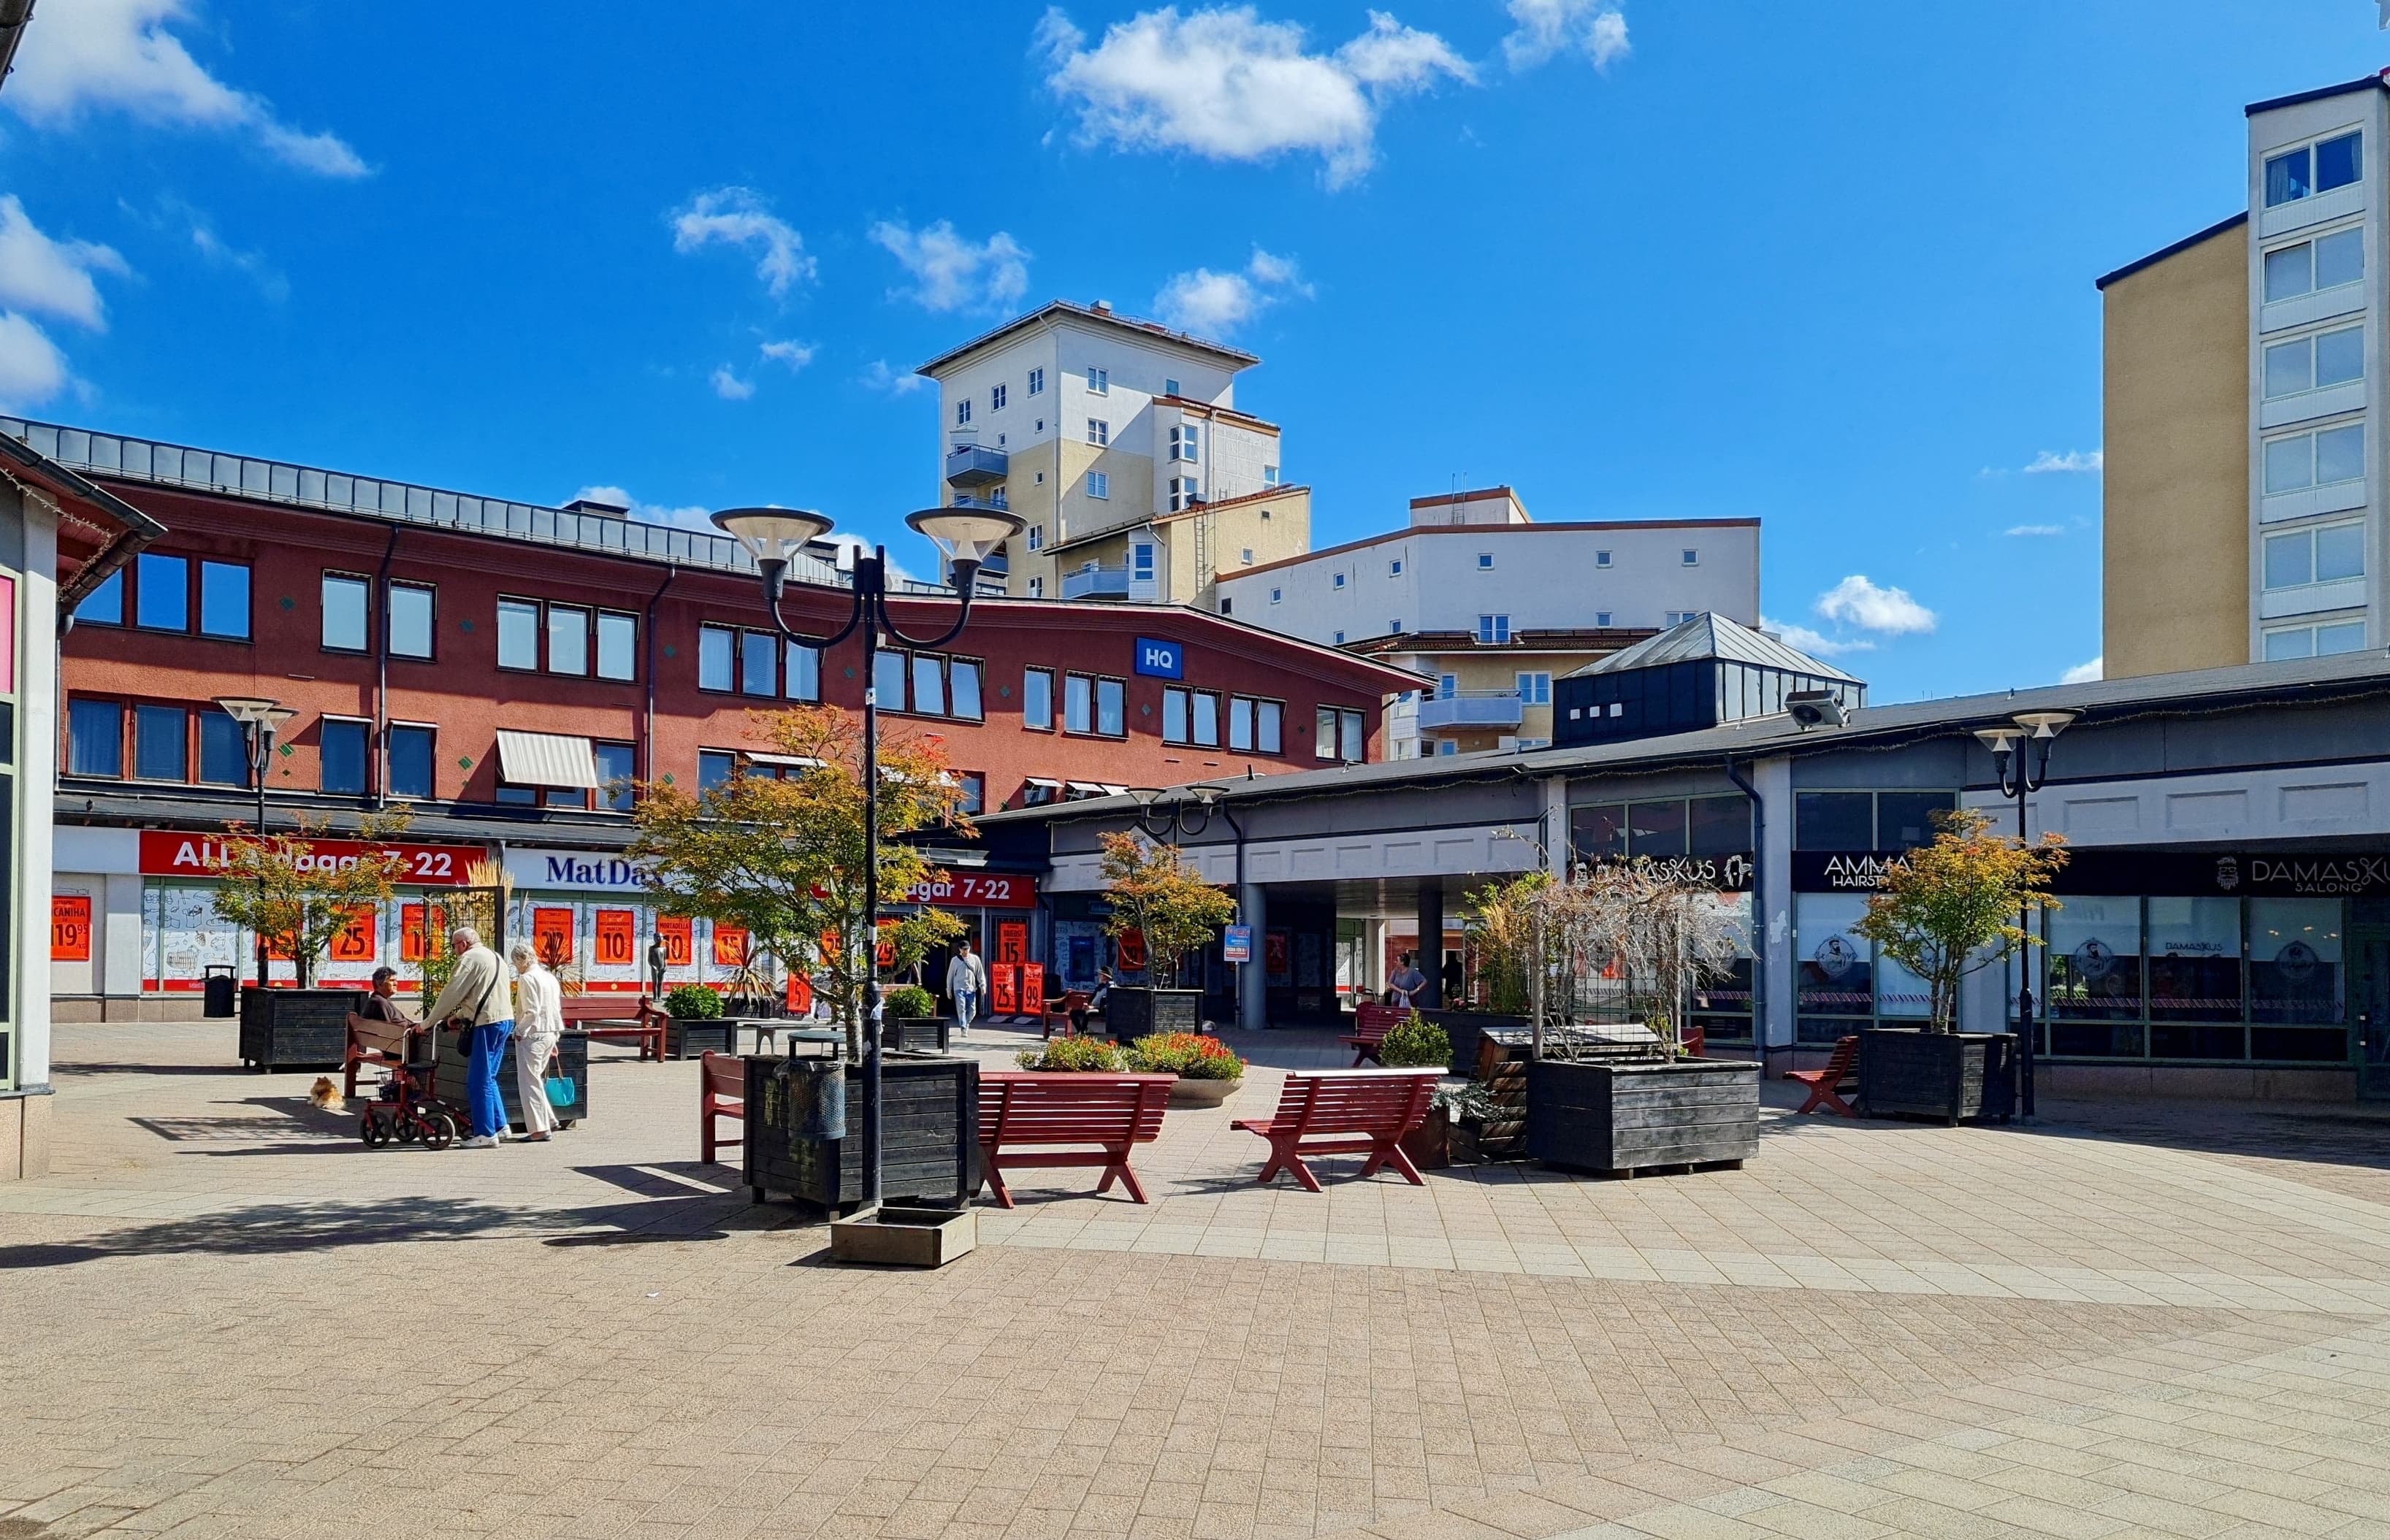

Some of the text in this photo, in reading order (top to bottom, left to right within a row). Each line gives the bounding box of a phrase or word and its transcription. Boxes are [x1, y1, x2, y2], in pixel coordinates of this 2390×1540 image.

[1145, 648, 1172, 669] HQ
[274, 844, 370, 877] daga
[382, 851, 451, 876] 7-22
[963, 879, 1009, 900] 7-22
[1833, 875, 1889, 887] HAIRST
[2295, 882, 2363, 893] SALONG
[51, 907, 85, 917] CANIHA
[340, 927, 365, 955] 25
[1004, 942, 1019, 962] 15
[996, 984, 1010, 1008] 25
[1026, 985, 1039, 1008] 99
